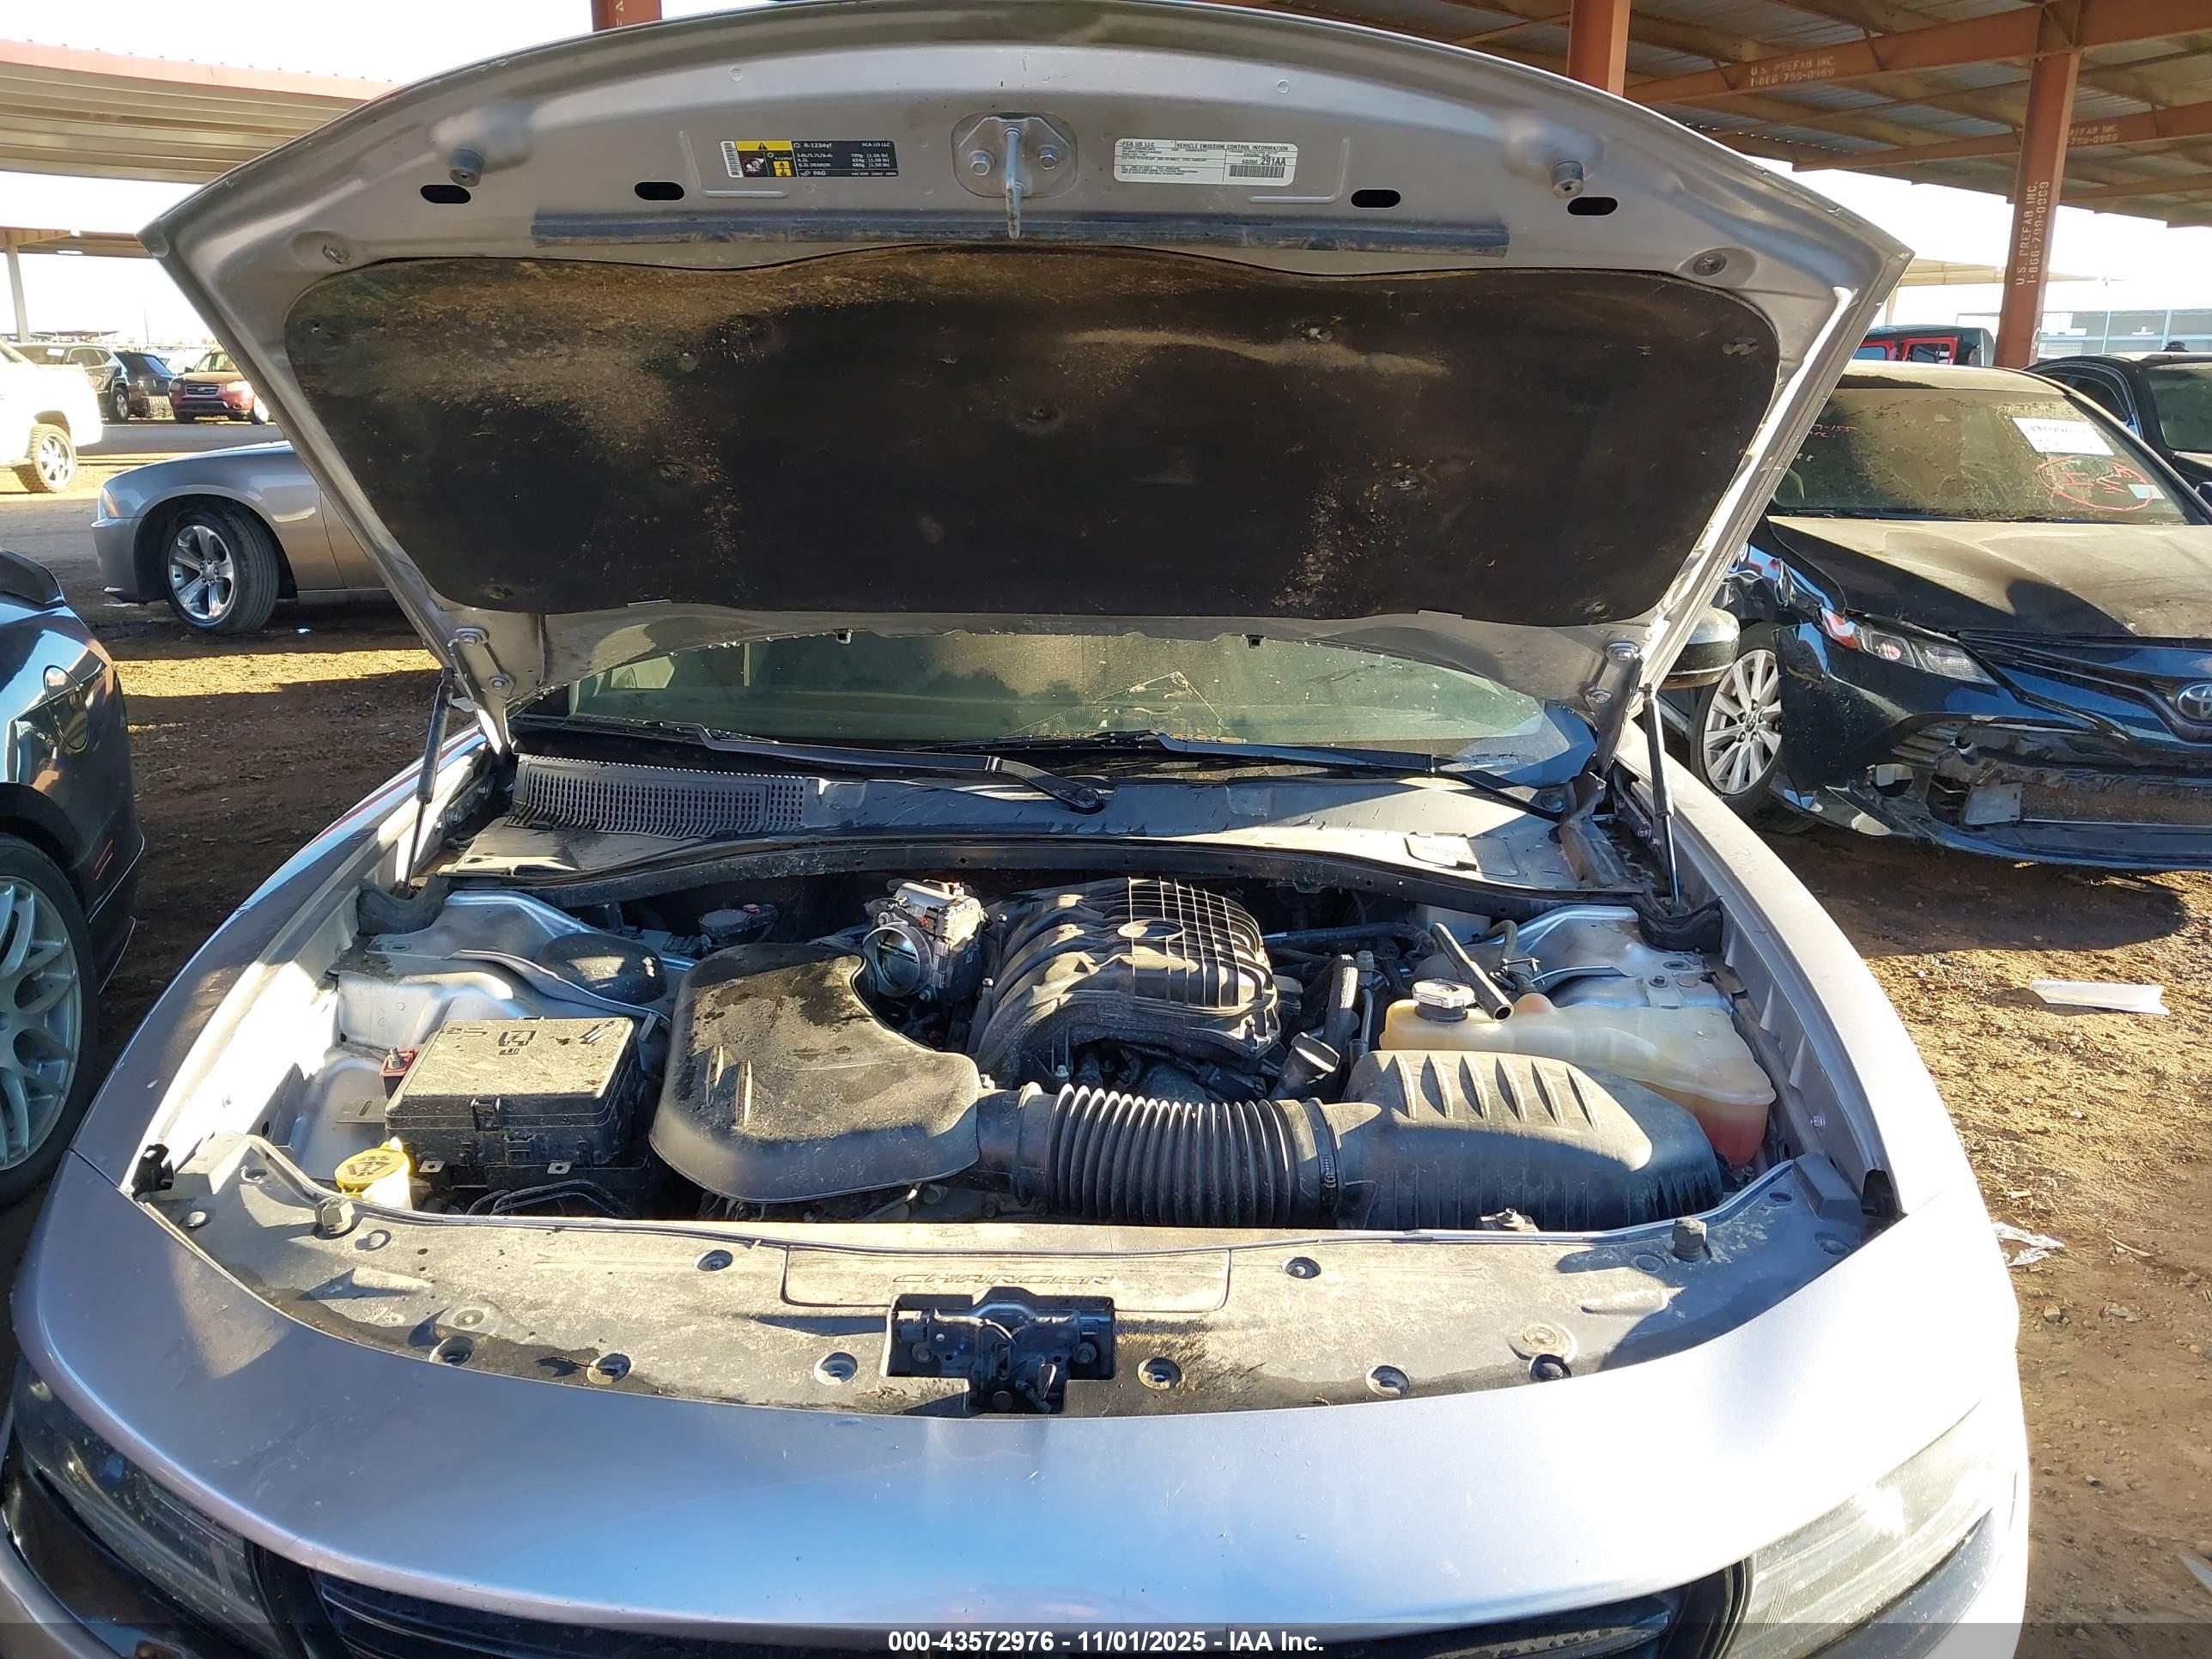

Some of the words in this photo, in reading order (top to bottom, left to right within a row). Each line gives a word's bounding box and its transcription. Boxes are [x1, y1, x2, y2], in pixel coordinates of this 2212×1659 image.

[1774, 59, 1813, 71] PREFAB
[2069, 126, 2099, 137] REFAB
[2067, 133, 2118, 145] -799-0969
[1261, 157, 1286, 166] 291AA
[2020, 210, 2034, 257] PREFAB
[2027, 181, 2039, 204] INC.
[2027, 181, 2050, 283] 1-866-799-0969
[892, 1273, 1115, 1285] CHARGER
